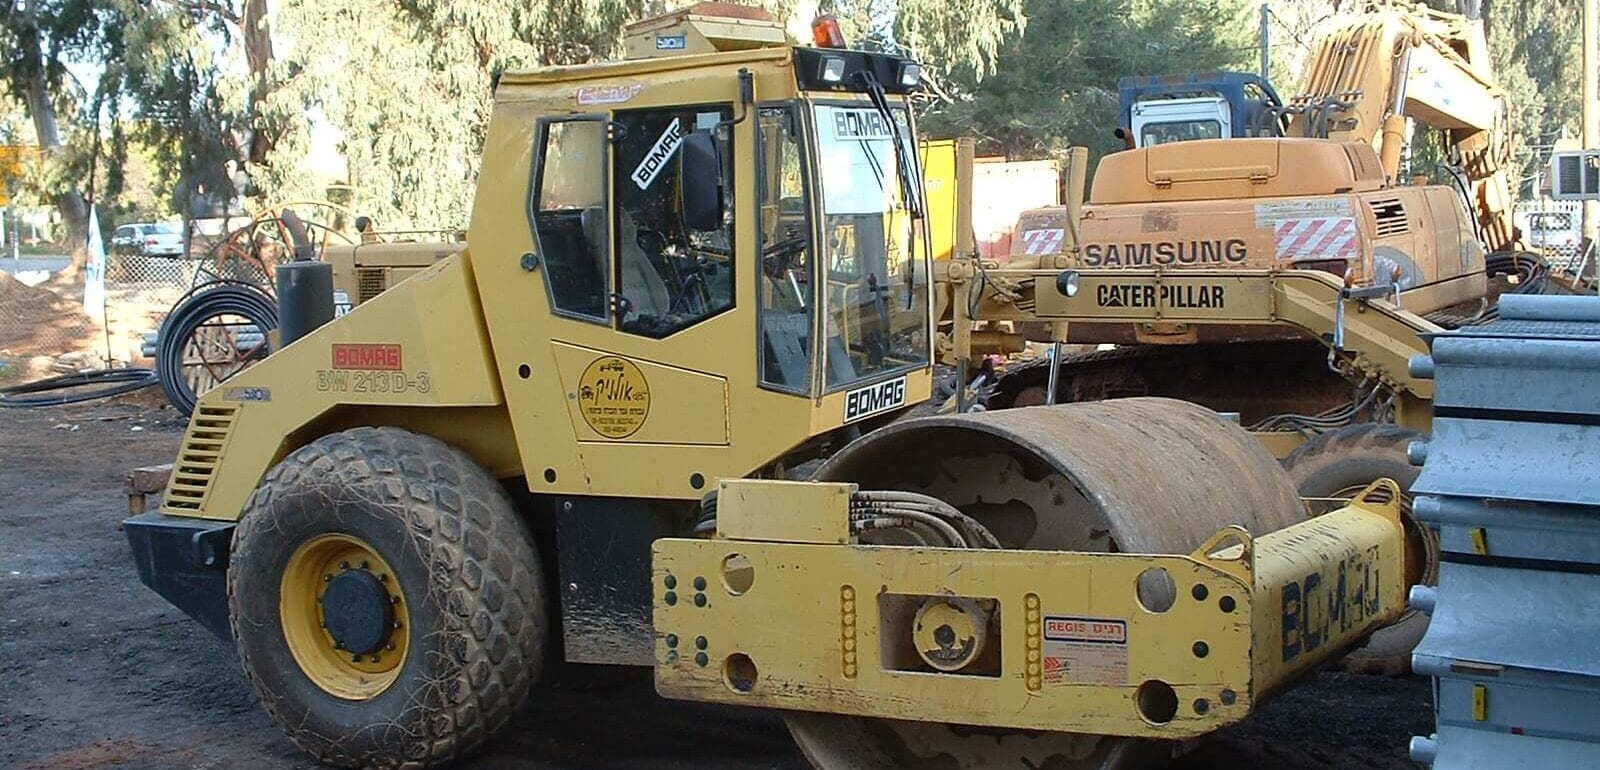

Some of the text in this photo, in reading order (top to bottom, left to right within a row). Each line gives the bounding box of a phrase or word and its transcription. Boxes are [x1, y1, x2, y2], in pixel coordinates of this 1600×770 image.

[1084, 239, 1247, 266] SAMSUNG
[1097, 284, 1224, 308] CATERPILLAR
[334, 347, 399, 367] BOMAG
[316, 370, 350, 392] BW
[353, 370, 390, 393] 213
[846, 379, 905, 419] BOMAG
[1047, 621, 1087, 633] REGIS
